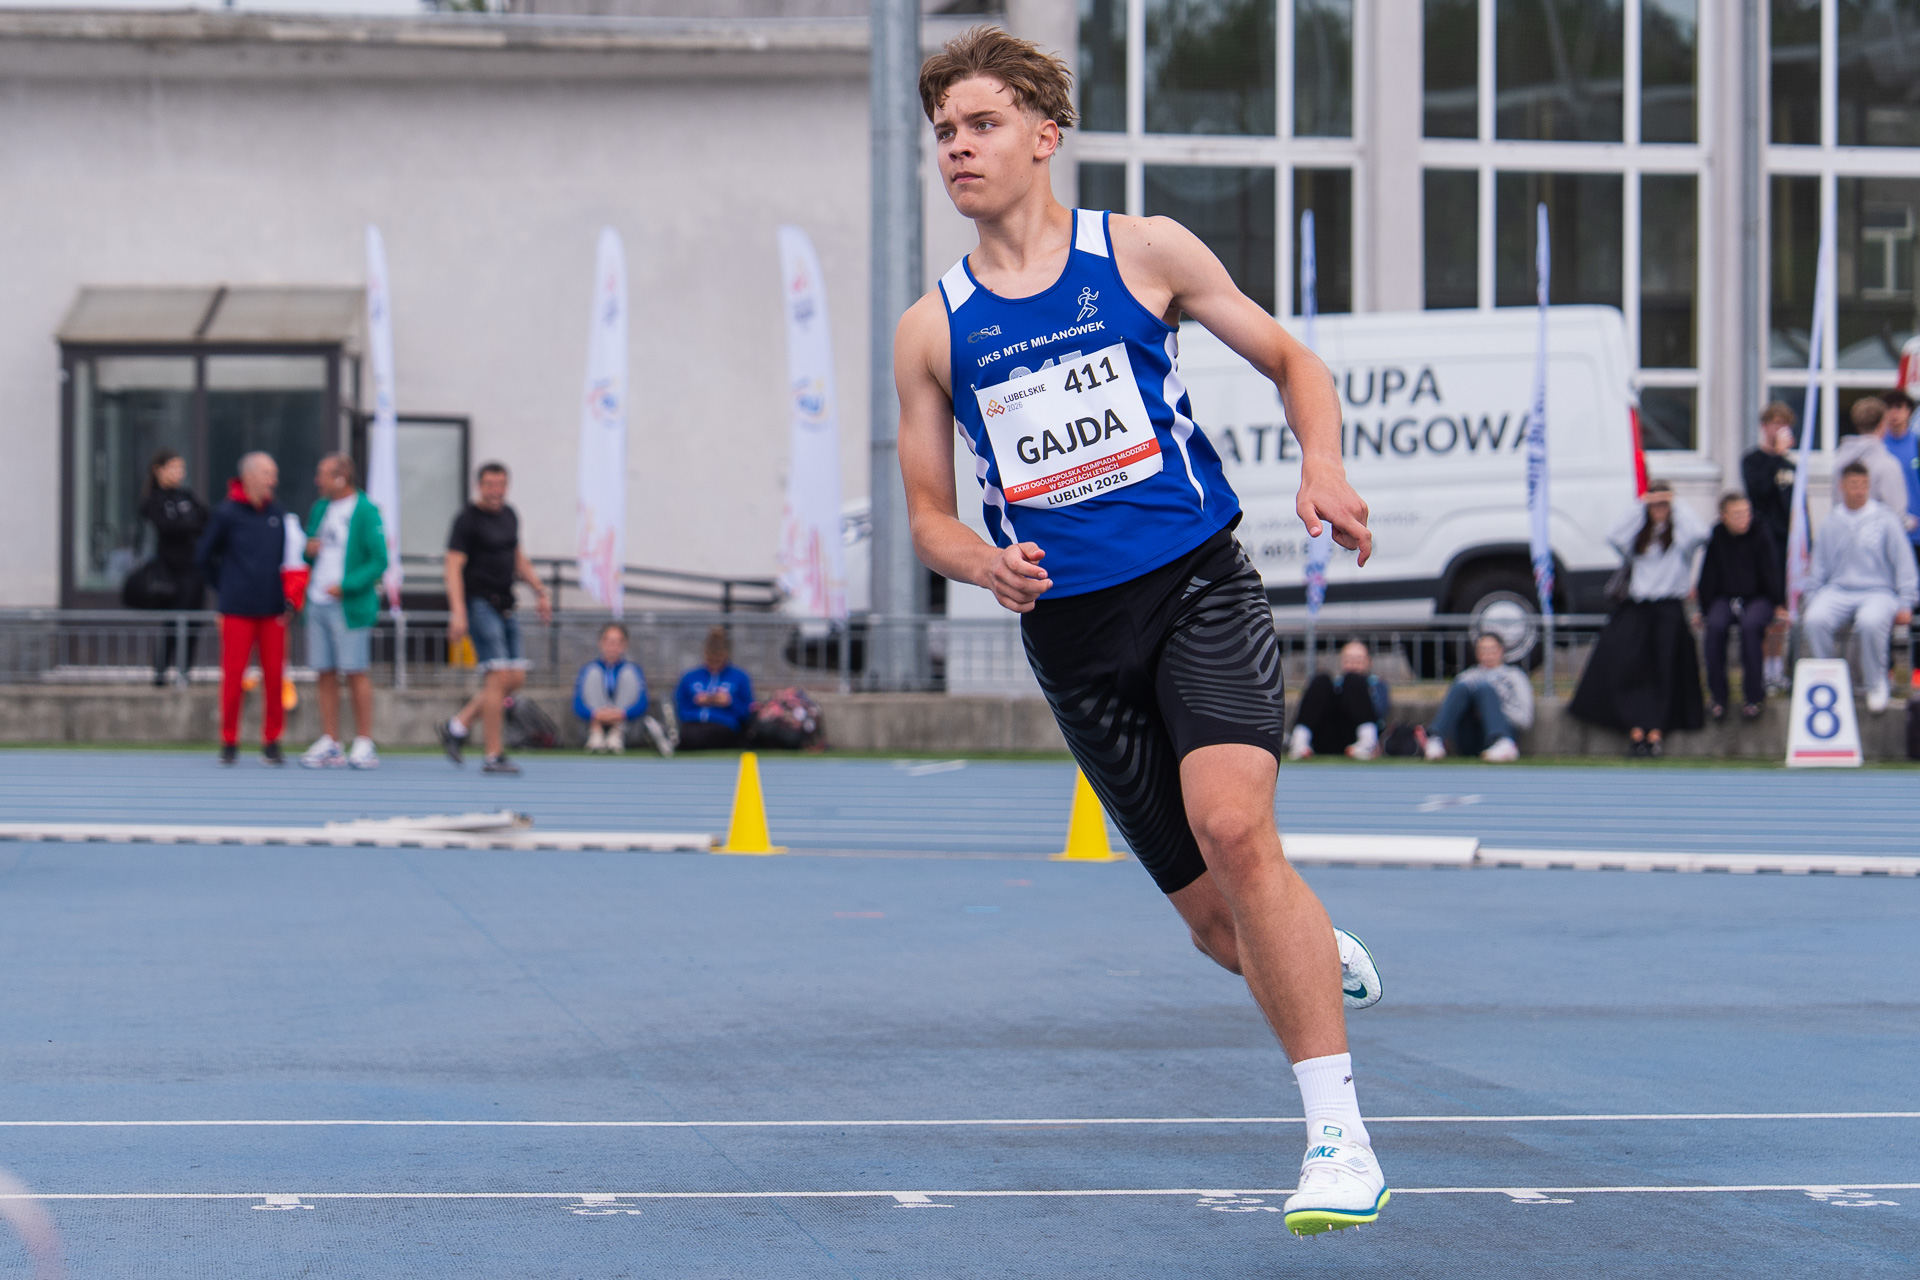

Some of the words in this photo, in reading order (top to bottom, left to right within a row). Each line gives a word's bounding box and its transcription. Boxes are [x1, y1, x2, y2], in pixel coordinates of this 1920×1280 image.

[977, 350, 1001, 367] UKS
[1003, 341, 1028, 357] MTE
[1030, 320, 1106, 348] MILANÓWEK
[1064, 356, 1119, 393] 411
[1276, 366, 1441, 408] UPA
[1003, 384, 1047, 403] LUBELSKIE
[1006, 401, 1024, 412] 2026
[1016, 408, 1128, 464] GAJDA
[1013, 483, 1030, 493] XXXII
[1030, 469, 1081, 488] OGÓLNOPOLSKA
[1081, 456, 1117, 472] OLIMPIADA
[1047, 483, 1093, 505] LUBLIN
[1095, 471, 1128, 490] 2026
[1057, 472, 1092, 488] SPORTACH
[1092, 463, 1119, 476] LETNICH
[1806, 685, 1841, 739] 8
[1306, 1145, 1340, 1161] NIKE
